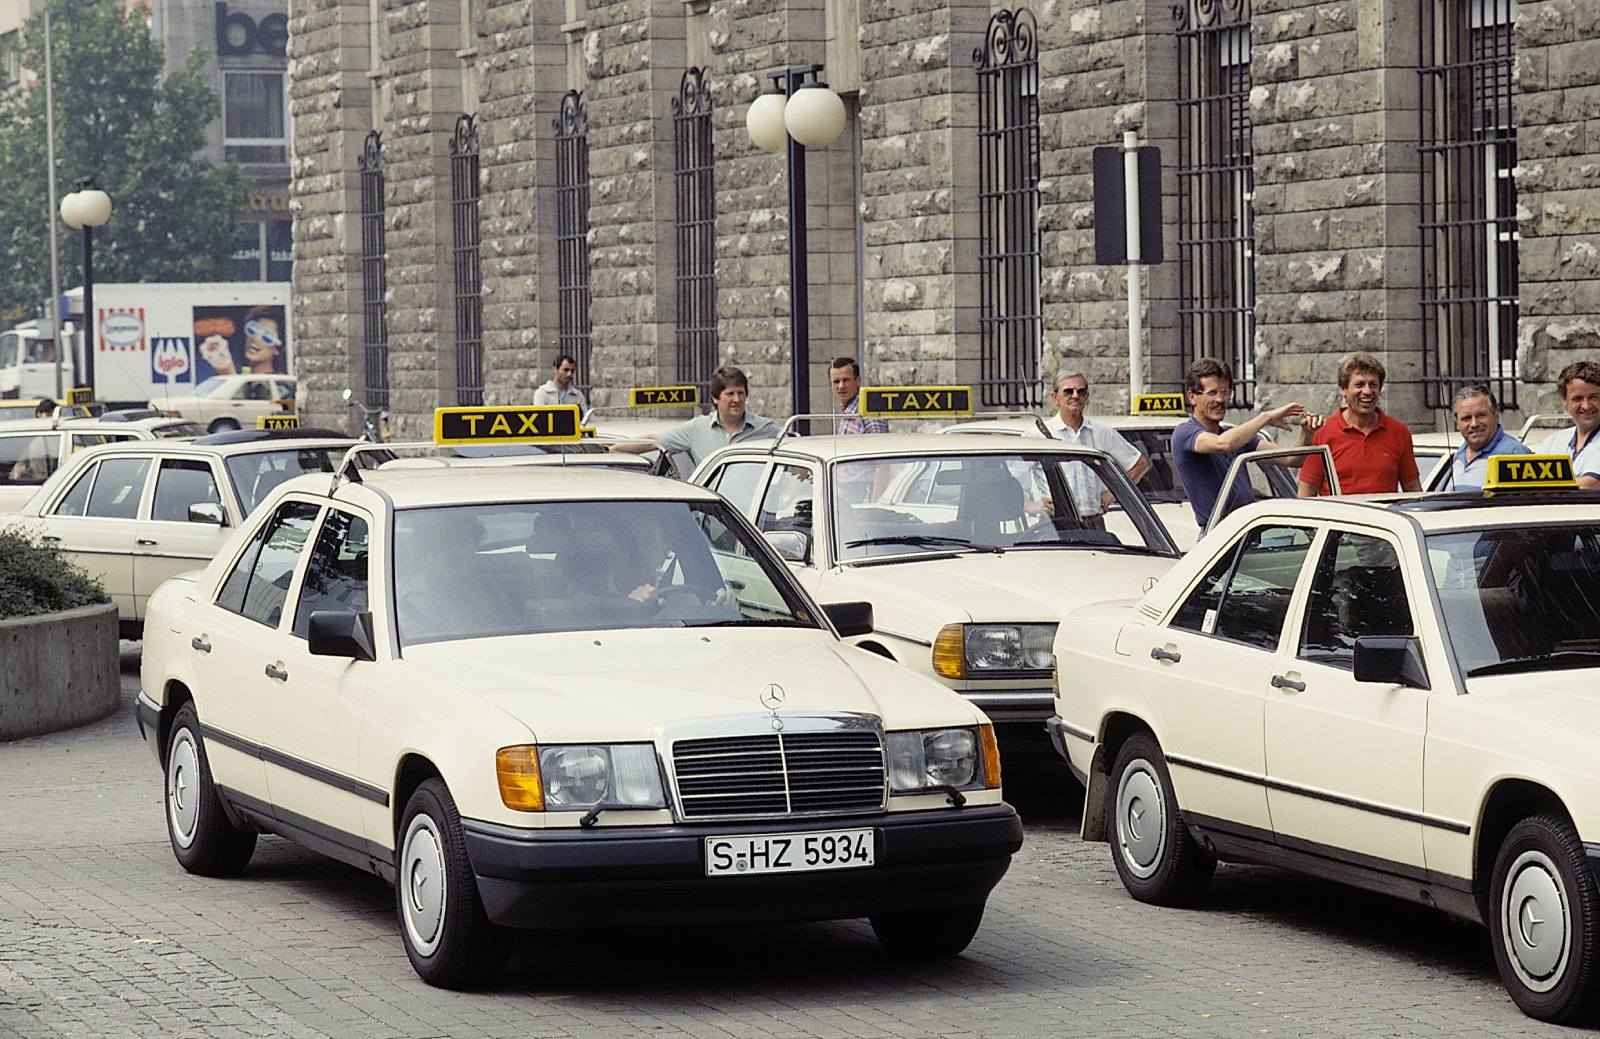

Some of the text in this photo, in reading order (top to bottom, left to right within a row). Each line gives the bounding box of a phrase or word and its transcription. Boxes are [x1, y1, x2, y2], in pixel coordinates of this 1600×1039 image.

[643, 390, 686, 403] TAXI
[881, 392, 952, 410] TAXI
[1144, 399, 1177, 409] TAXI
[268, 420, 294, 430] TAXI
[461, 413, 554, 436] TAXI
[1507, 462, 1563, 480] TAXI
[713, 833, 869, 871] S-HZ 5934
